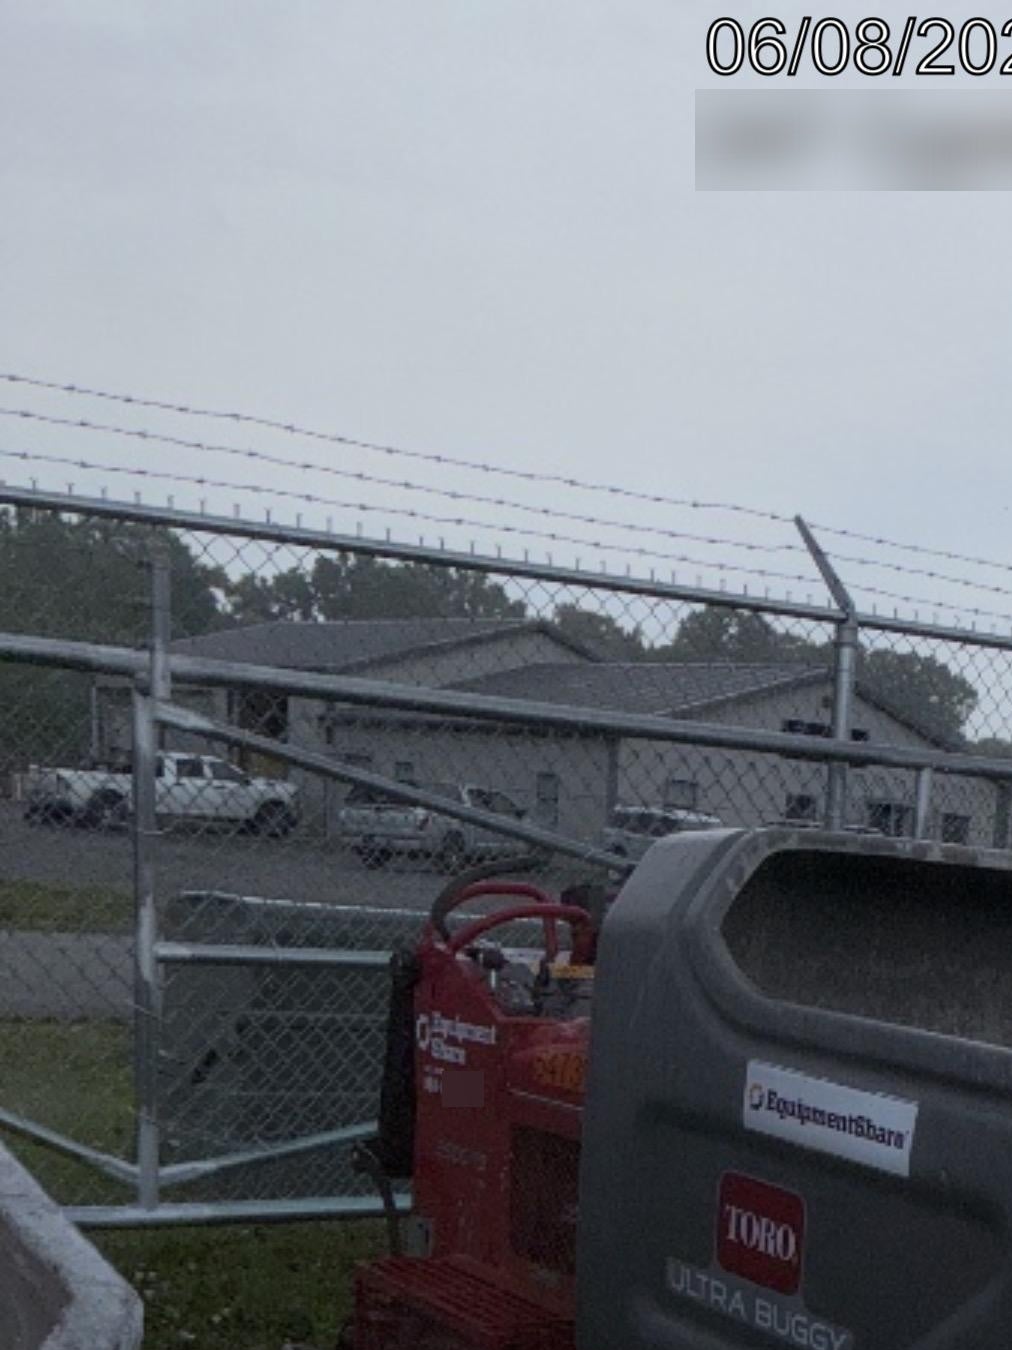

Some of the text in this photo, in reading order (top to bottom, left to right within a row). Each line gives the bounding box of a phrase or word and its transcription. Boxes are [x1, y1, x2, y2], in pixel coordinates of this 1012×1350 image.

[766, 1088, 905, 1150] EquipmentShare
[726, 1203, 796, 1261] TORO
[671, 1263, 749, 1321] ULTRA
